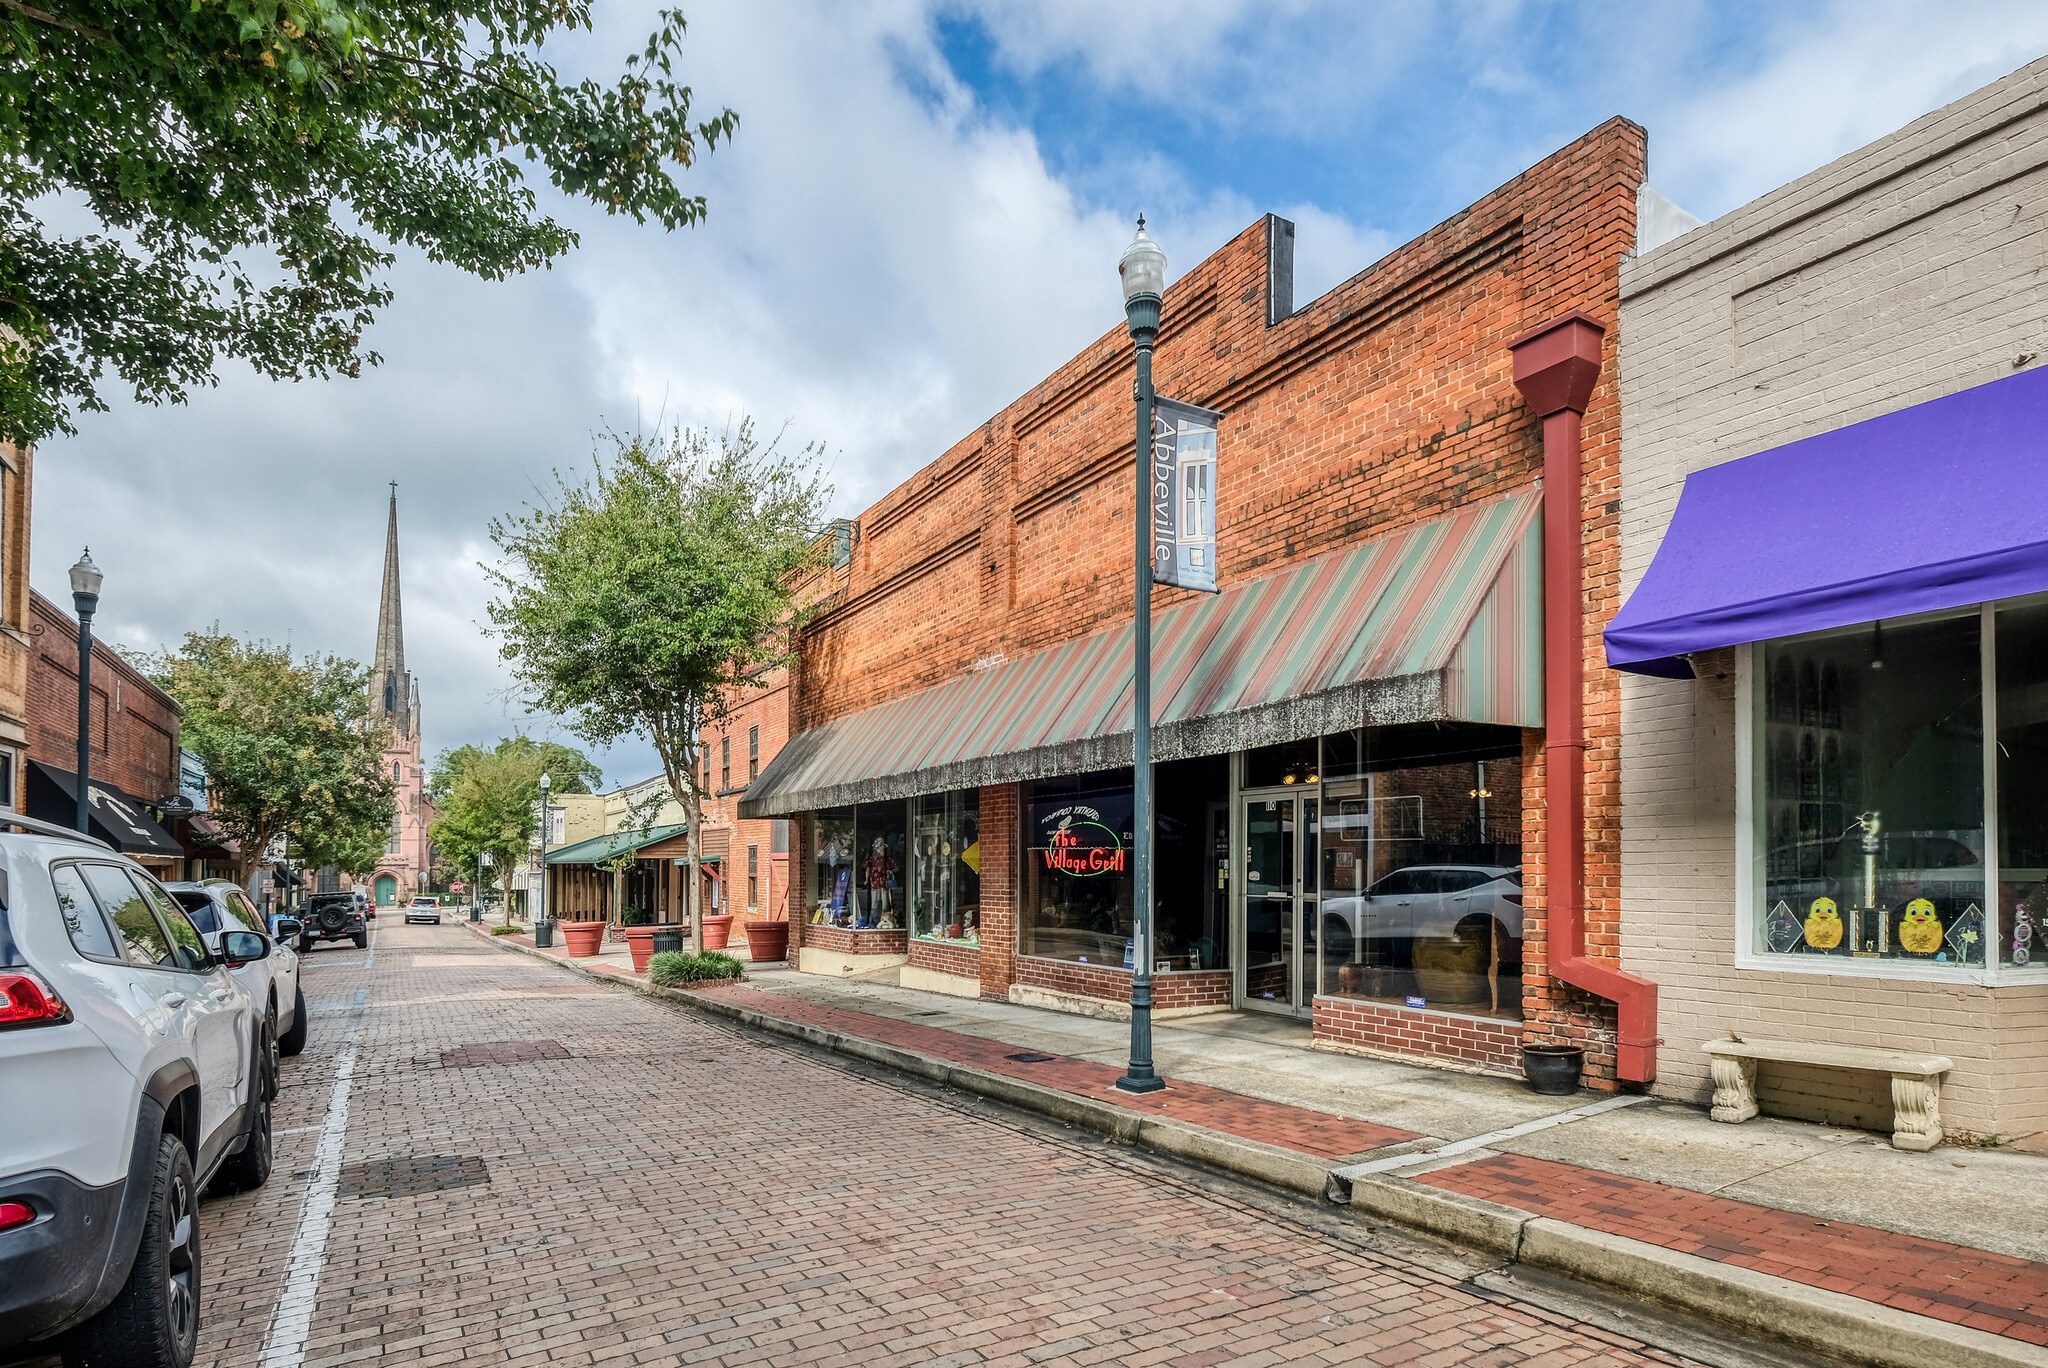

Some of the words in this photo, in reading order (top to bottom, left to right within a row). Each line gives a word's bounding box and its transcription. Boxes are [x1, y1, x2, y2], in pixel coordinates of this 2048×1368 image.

[1154, 415, 1177, 562] Abbeville
[1266, 801, 1276, 810] 110
[1045, 848, 1087, 874] Village
[1089, 848, 1125, 872] Grill
